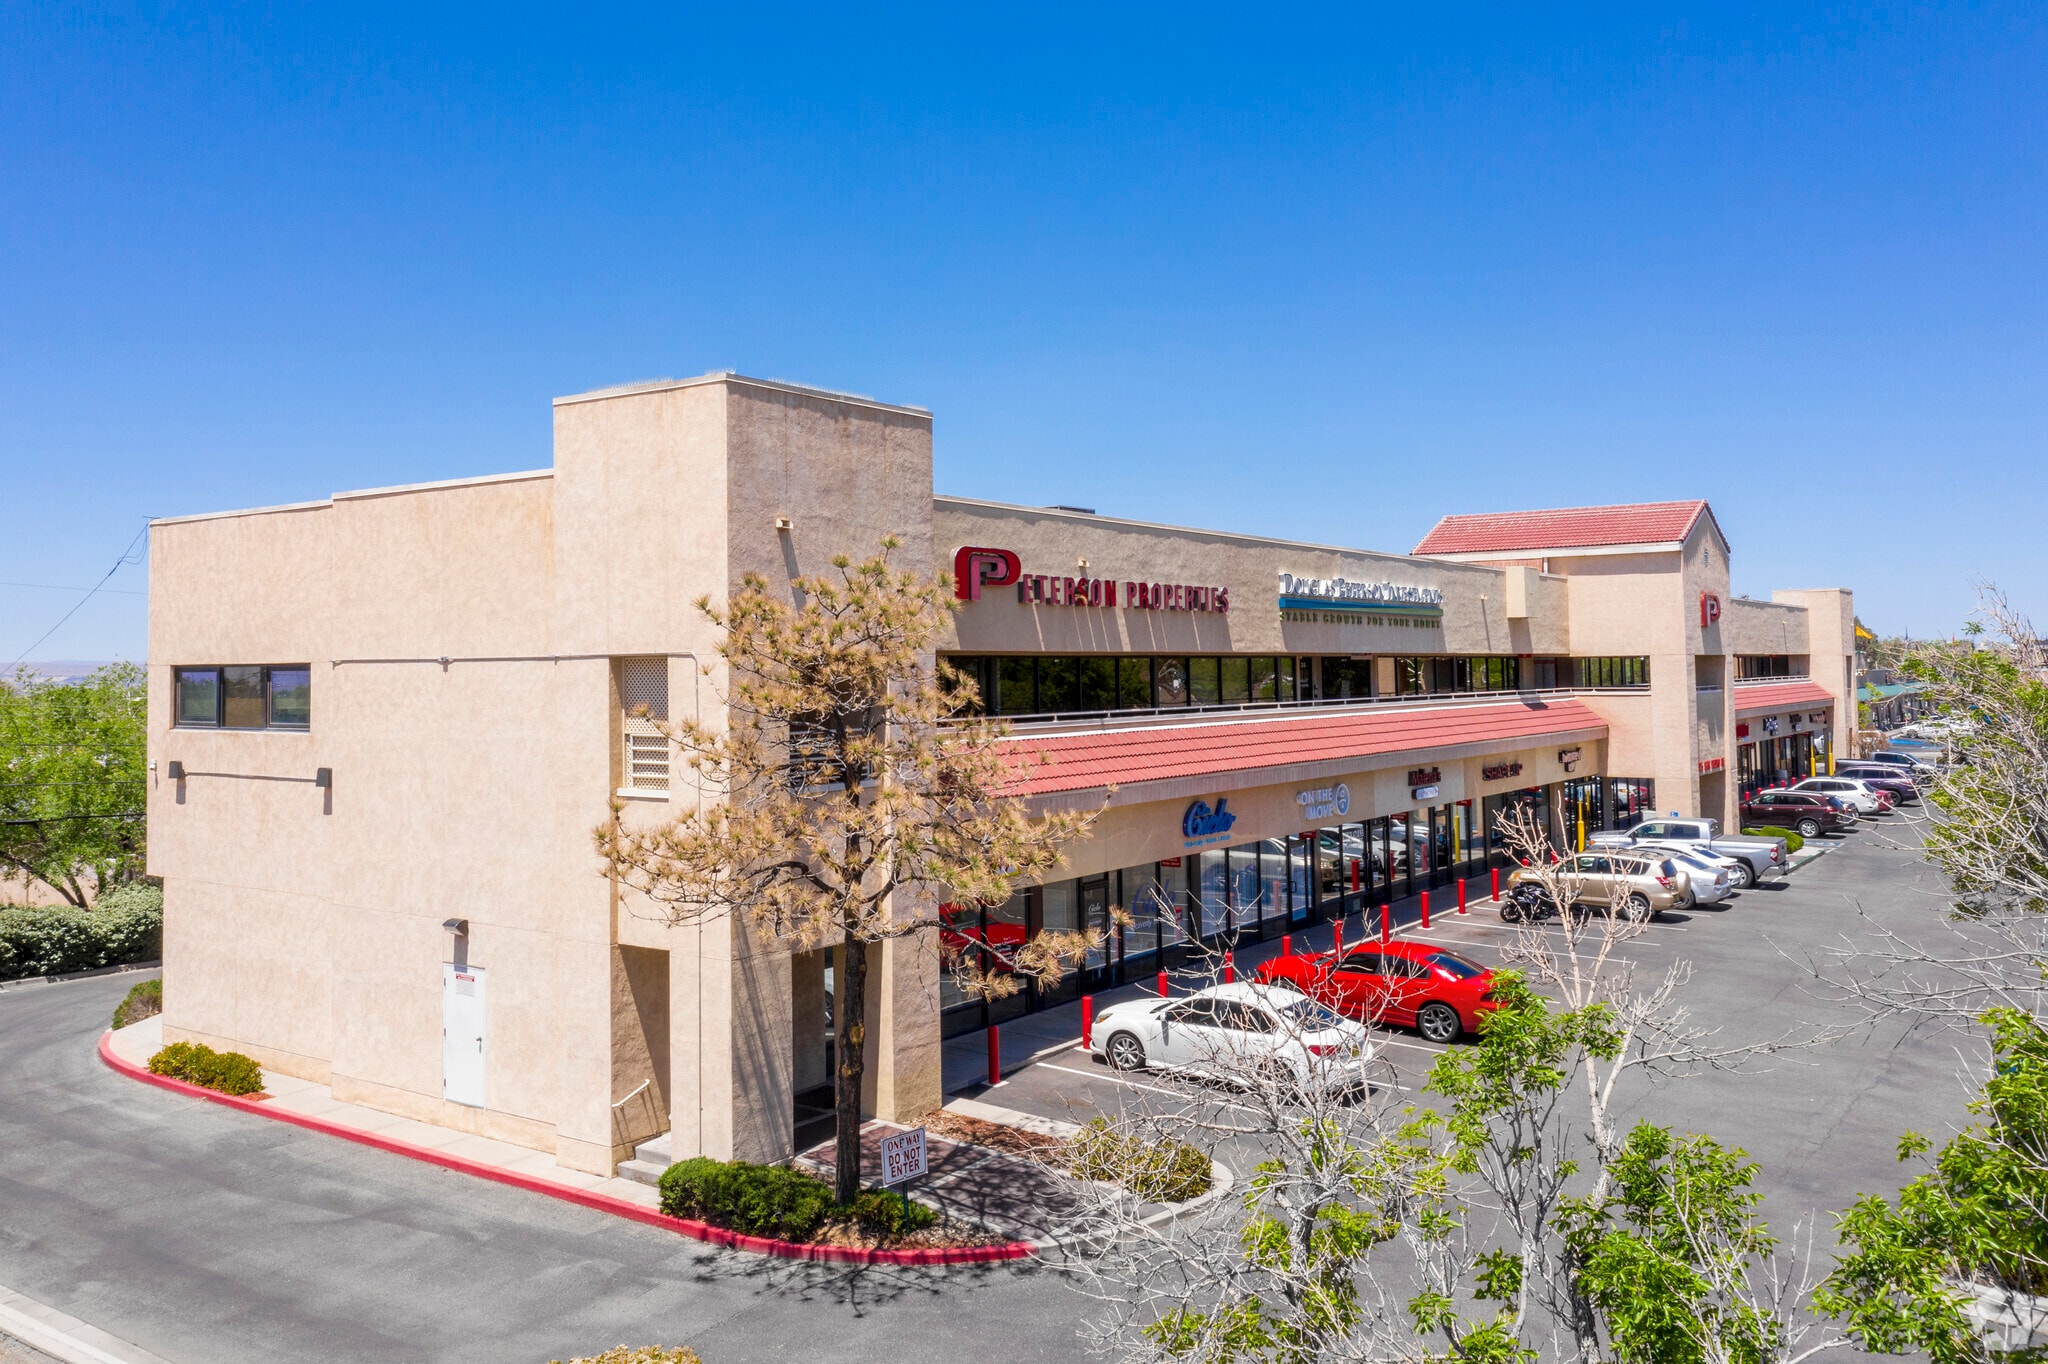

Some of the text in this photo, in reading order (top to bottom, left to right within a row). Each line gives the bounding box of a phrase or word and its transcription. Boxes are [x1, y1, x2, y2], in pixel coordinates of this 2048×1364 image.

[1126, 581, 1230, 614] PROPERTIES
[1280, 611, 1440, 629] STABLE GROWTH FOR YOUR MONEY
[1300, 790, 1315, 805] ON
[1317, 787, 1333, 803] THE
[1306, 803, 1334, 820] MOVE
[888, 1133, 920, 1151] ONE WAY
[888, 1146, 920, 1167] DO NOT
[891, 1159, 919, 1178] ENTER
